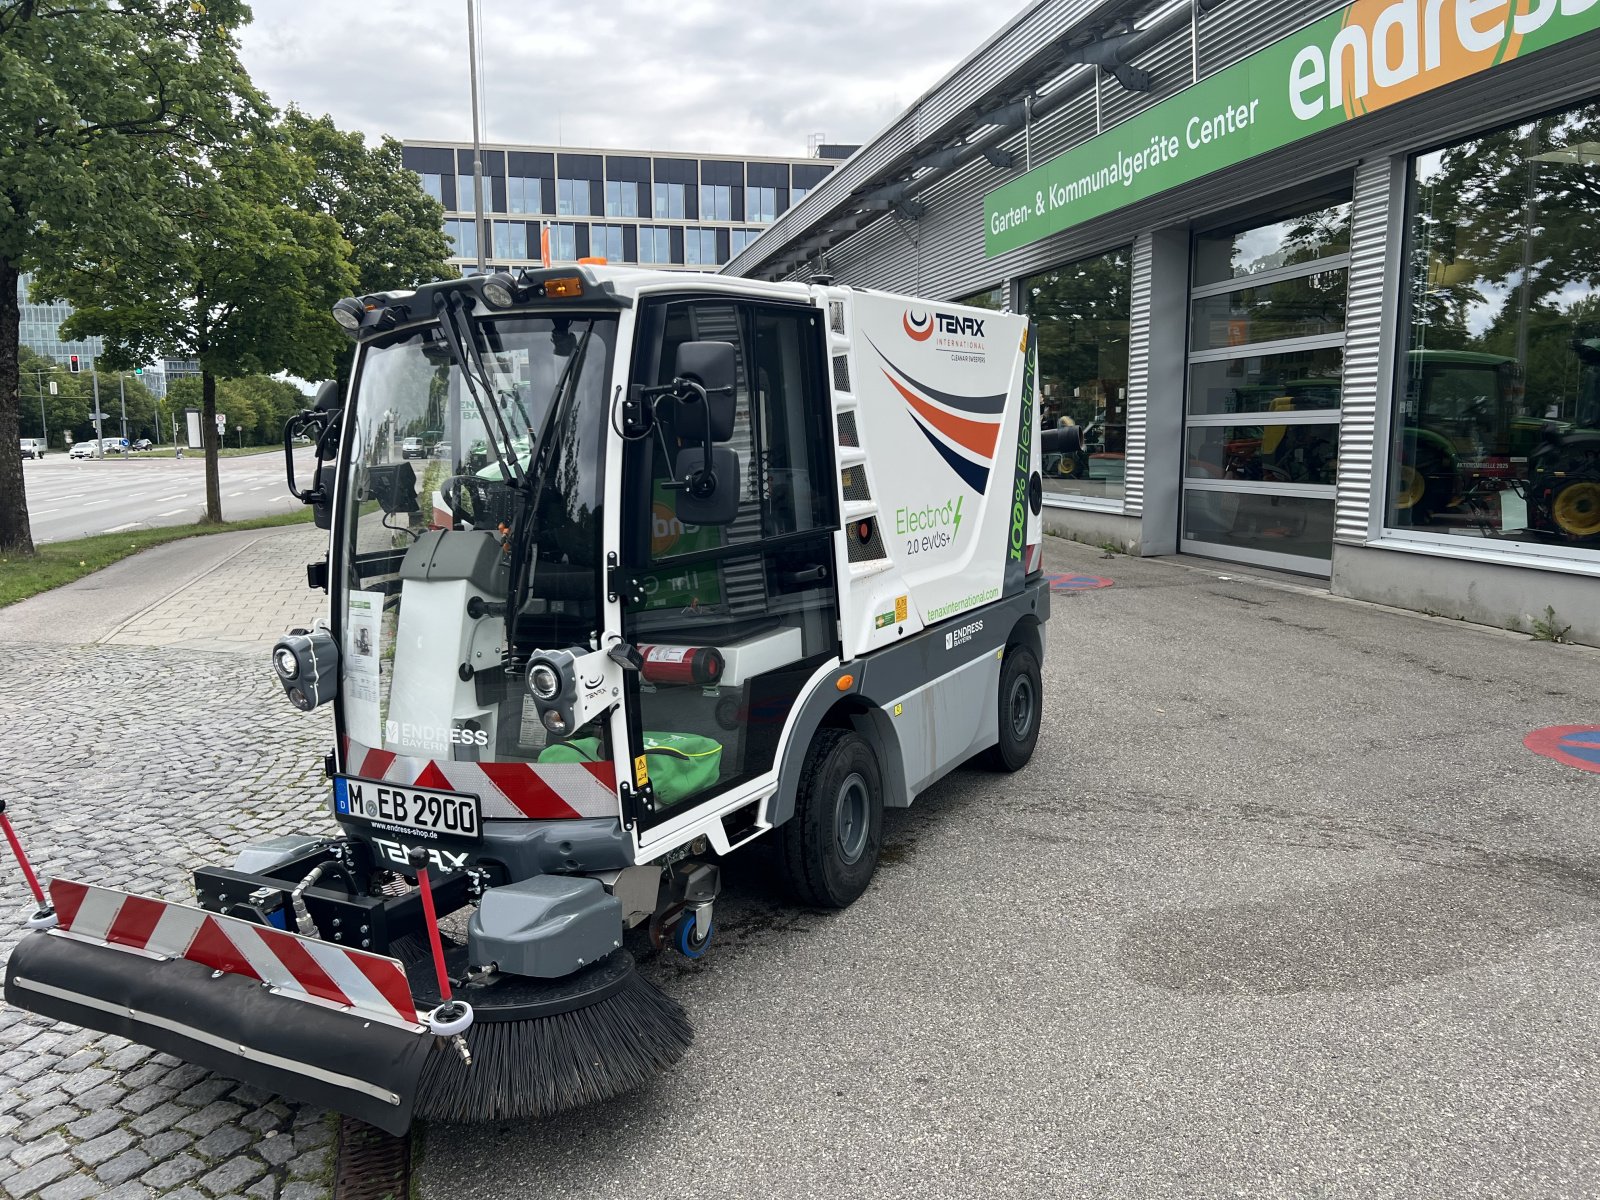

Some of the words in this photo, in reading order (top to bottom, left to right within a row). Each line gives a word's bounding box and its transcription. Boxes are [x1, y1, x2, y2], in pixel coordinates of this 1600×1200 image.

[1289, 0, 1599, 121] endre
[991, 207, 1031, 235] Garten-
[1035, 191, 1045, 216] &
[1049, 135, 1179, 210] Kommunalgeräte
[1185, 99, 1259, 150] Center
[936, 313, 985, 342] TENAX
[936, 338, 985, 350] INTERNATIONAL
[1017, 347, 1036, 474] Electric
[896, 503, 950, 534] Electra
[1011, 478, 1026, 562] 100%
[907, 539, 919, 555] 2.0
[927, 587, 998, 621] tenaxinternational.com
[953, 620, 984, 640] ENDRESS
[953, 635, 972, 647] BAYERN
[402, 723, 488, 746] ENDRESS
[402, 738, 448, 752] BAYERN
[341, 800, 346, 809] D
[348, 783, 364, 815] M
[378, 788, 408, 822] EB
[413, 794, 475, 833] 2900
[371, 821, 438, 839] www.endress-shop.de
